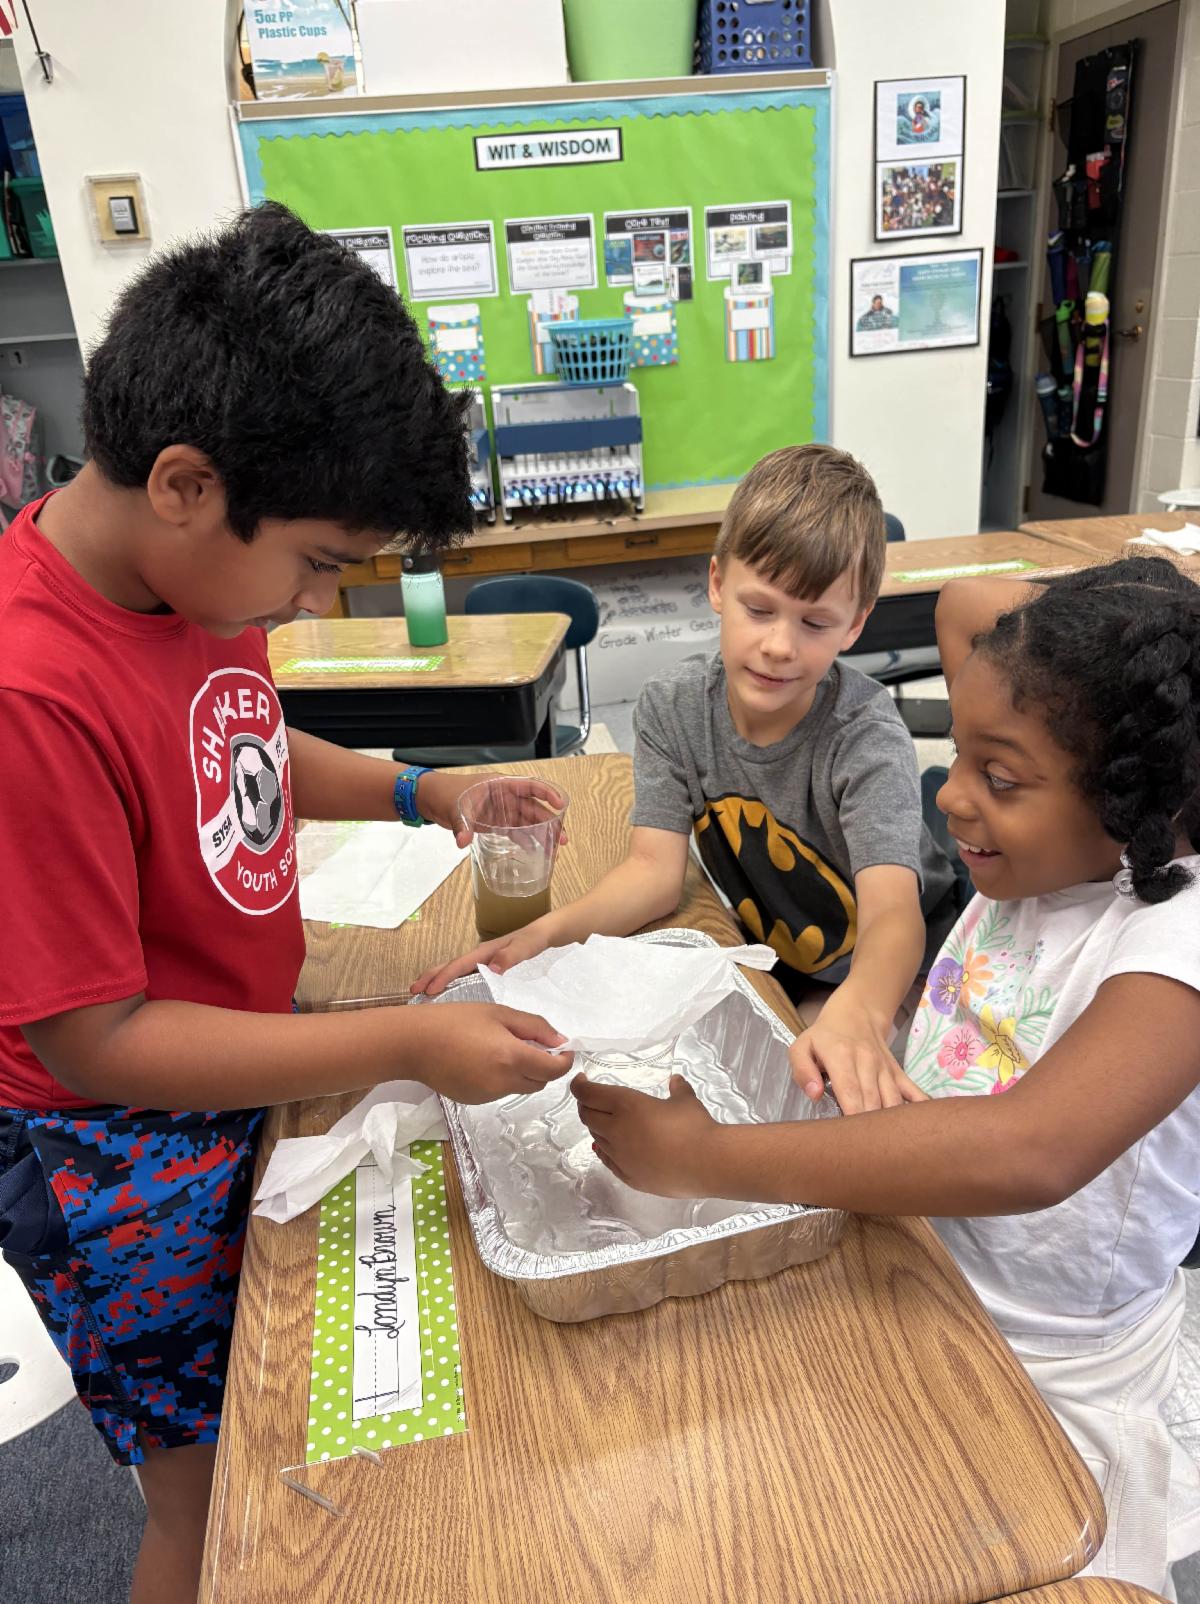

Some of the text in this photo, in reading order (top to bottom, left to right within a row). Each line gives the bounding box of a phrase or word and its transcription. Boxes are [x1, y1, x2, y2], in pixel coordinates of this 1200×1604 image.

[254, 9, 293, 24] 5oz PP
[258, 25, 327, 39] Plastic Cups
[488, 137, 612, 161] WIT & WISDOM
[599, 634, 638, 649] Grade
[644, 625, 682, 642] Winter
[237, 860, 278, 892] YOUTH
[358, 1204, 398, 1269] Brown
